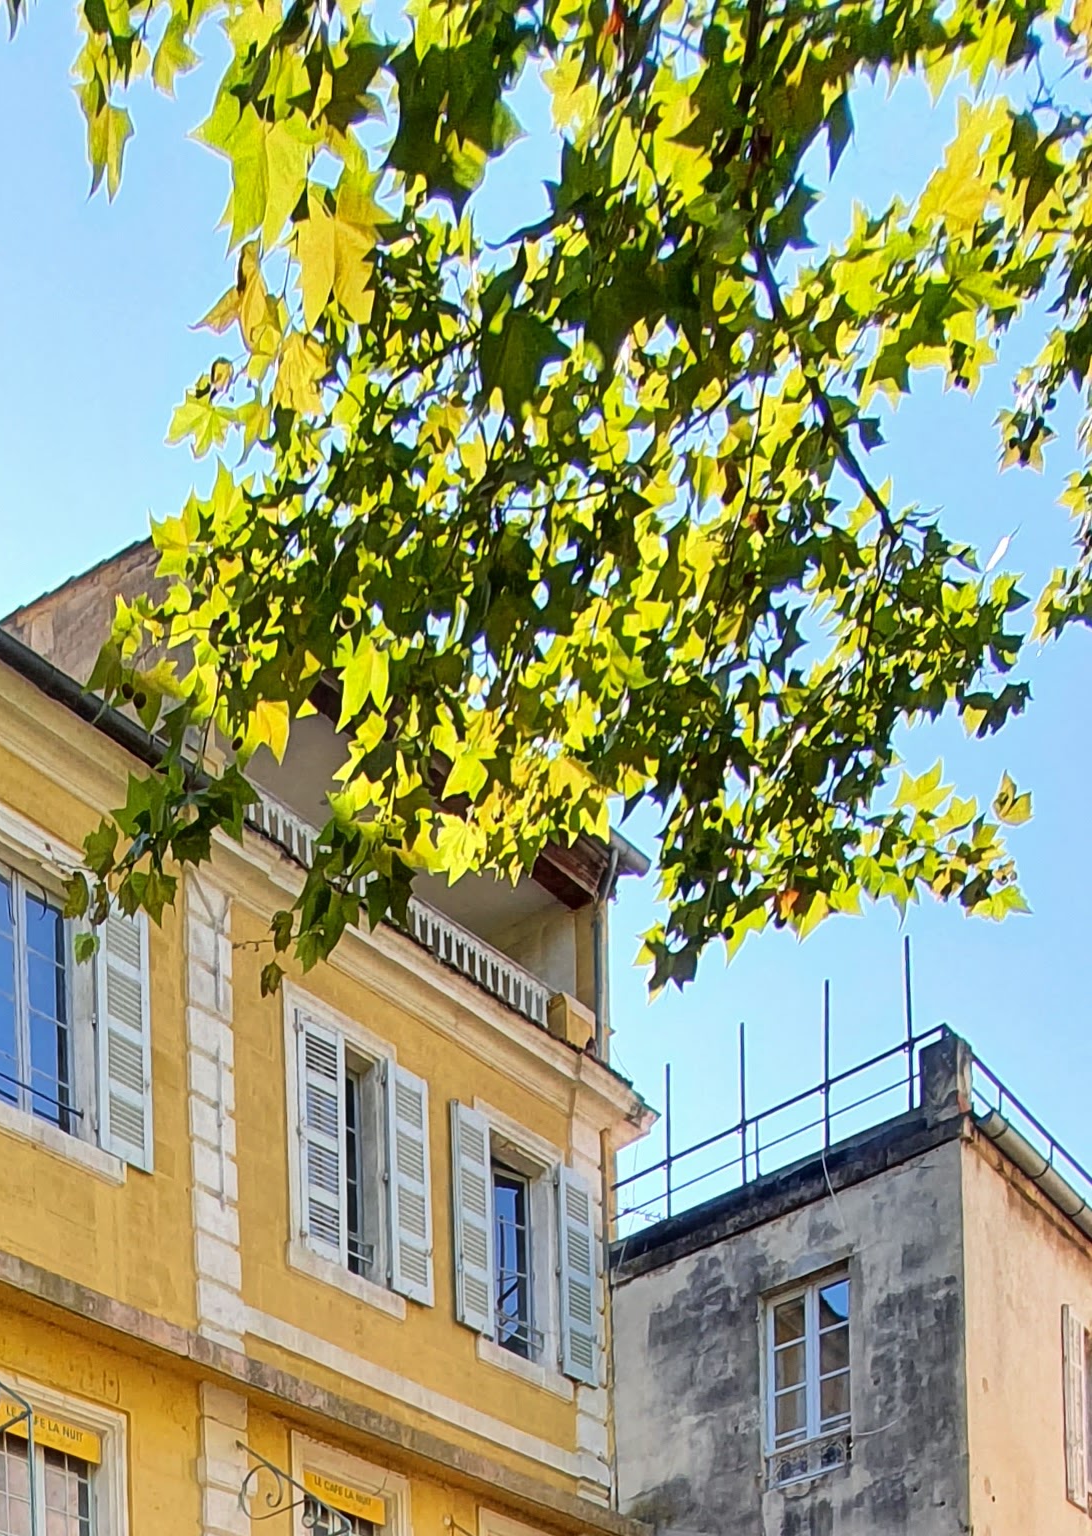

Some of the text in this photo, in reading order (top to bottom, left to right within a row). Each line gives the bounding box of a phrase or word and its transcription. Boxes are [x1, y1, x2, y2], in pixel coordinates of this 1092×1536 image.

[6, 1405, 15, 1417] LE
[48, 1421, 59, 1434] LA
[63, 1427, 83, 1443] NUIT
[344, 1487, 354, 1500] LA
